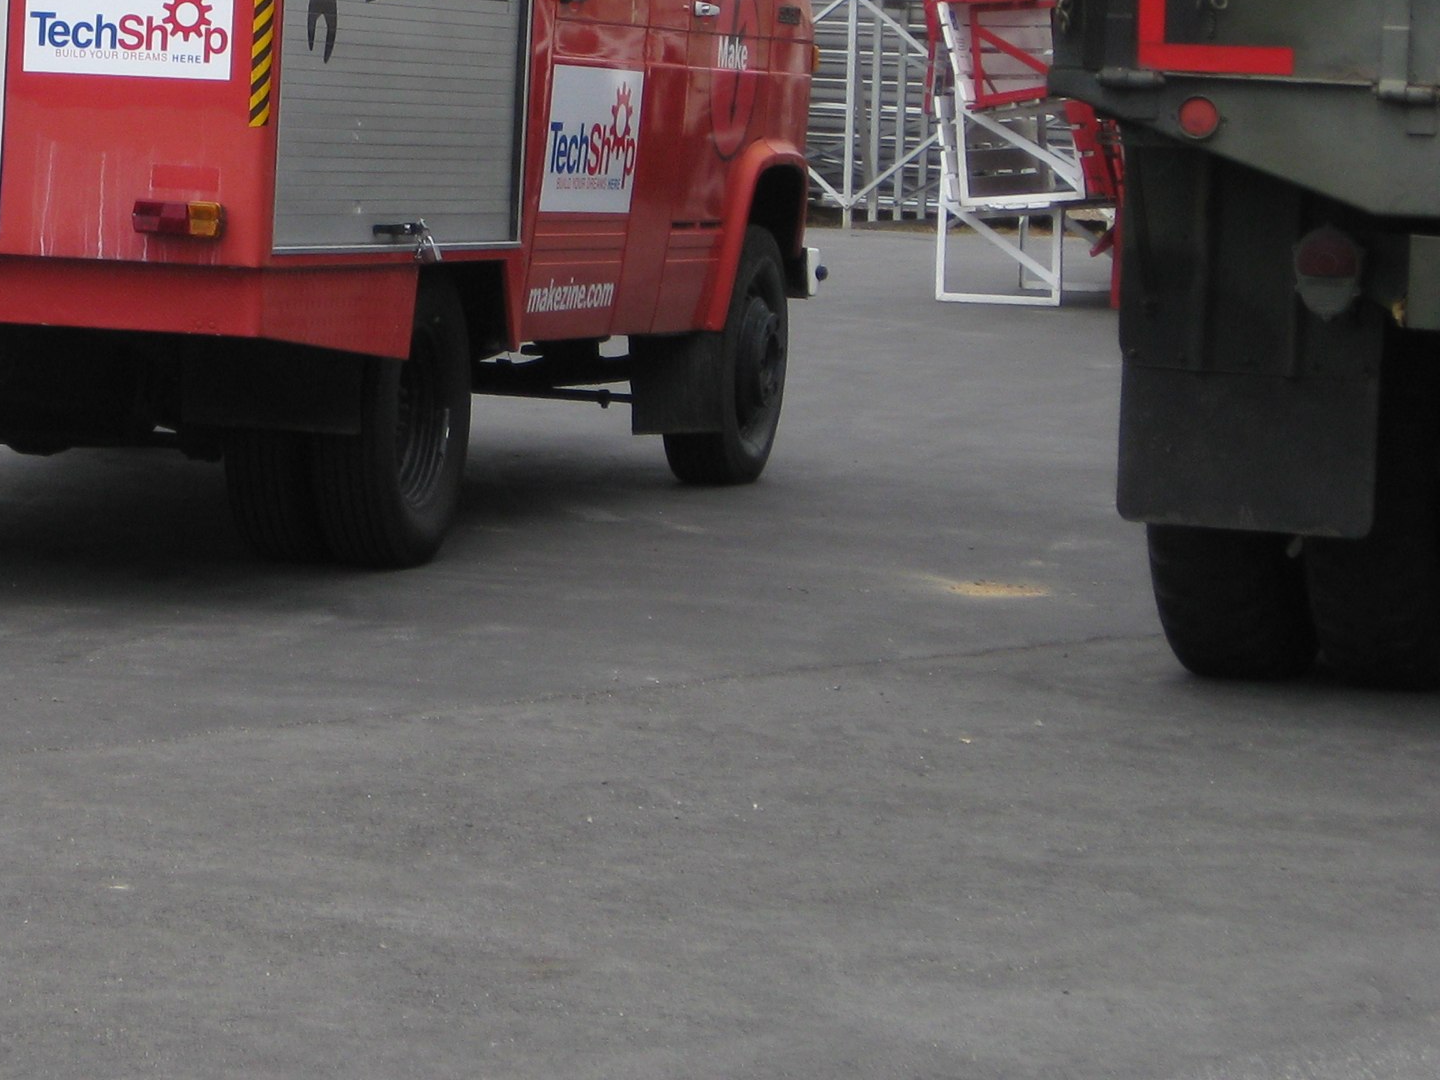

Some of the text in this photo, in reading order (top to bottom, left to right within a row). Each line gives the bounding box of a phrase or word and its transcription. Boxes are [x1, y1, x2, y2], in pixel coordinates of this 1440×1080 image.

[55, 48, 202, 64] BUILD YOUR DREAMS HERE
[717, 35, 748, 71] Make
[527, 276, 614, 313] makezine.com
